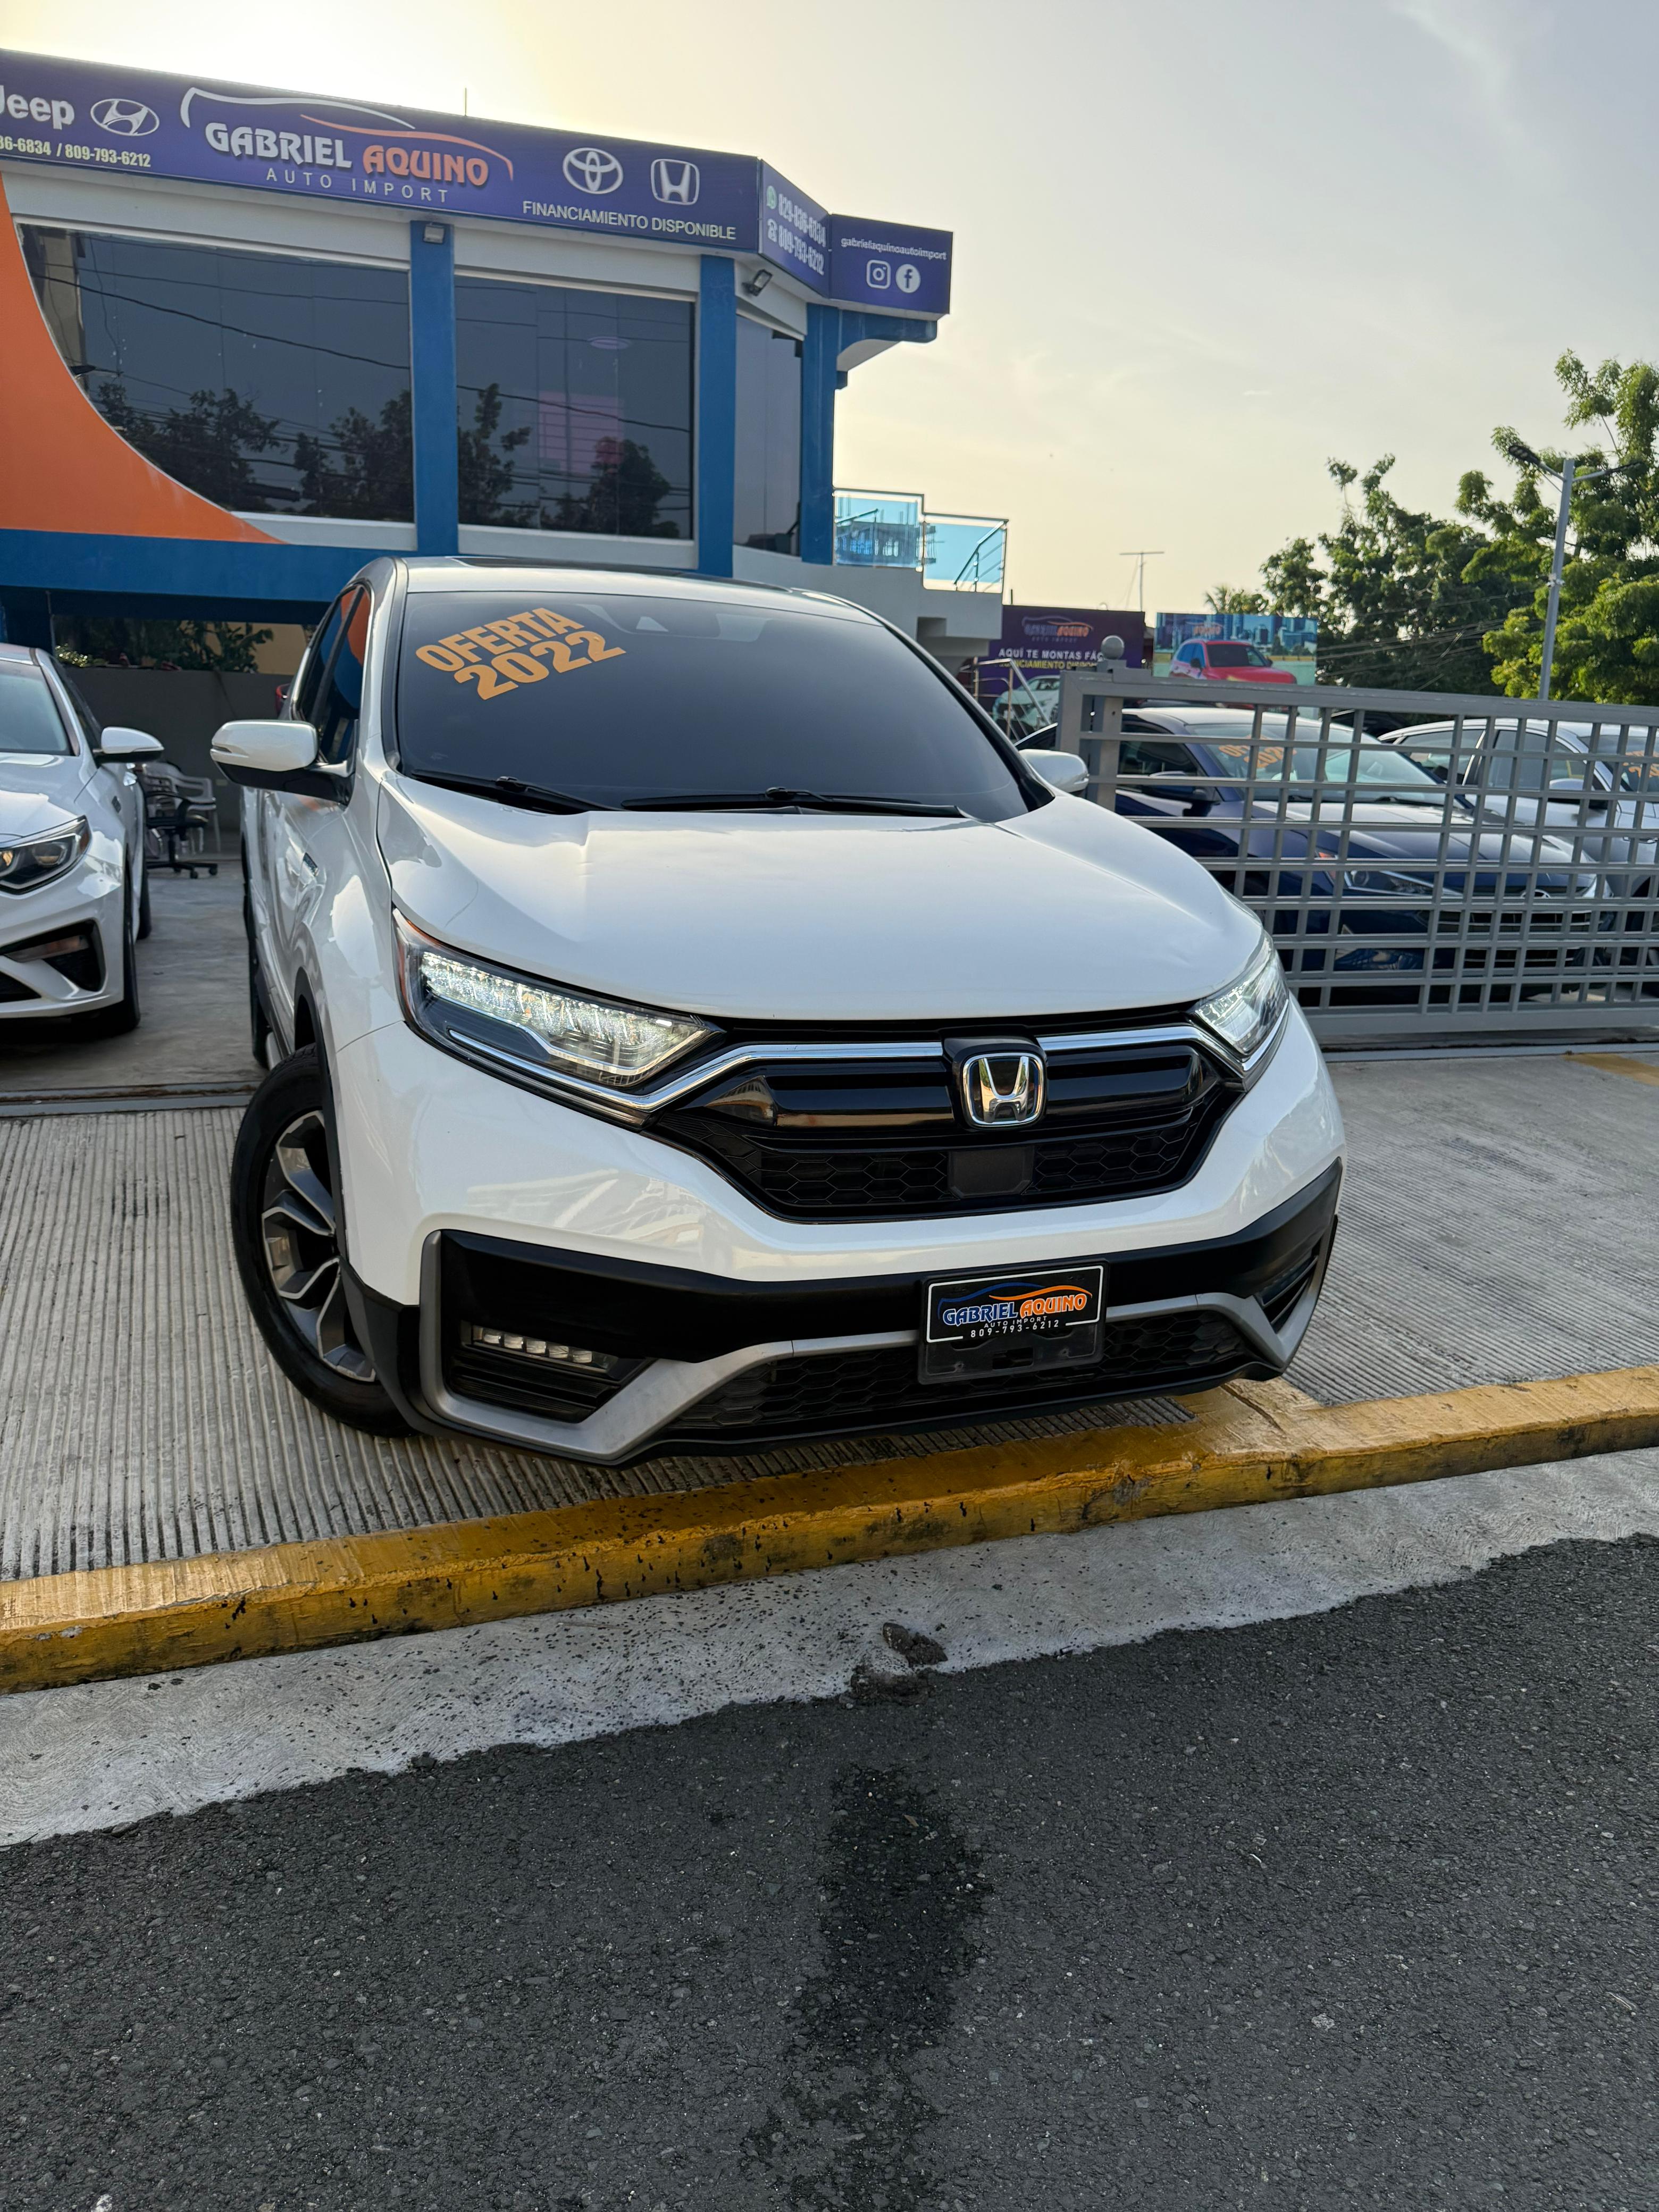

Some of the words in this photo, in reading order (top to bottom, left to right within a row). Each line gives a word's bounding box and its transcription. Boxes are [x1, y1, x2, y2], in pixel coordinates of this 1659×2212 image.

[65, 144, 152, 167] 809-793-6212
[205, 122, 353, 169] GABRIEL
[363, 145, 489, 186] AQUINO
[266, 167, 332, 188] AUTO
[352, 178, 448, 203] IMPORT
[522, 200, 648, 229] FINANCIAMIENTO
[651, 217, 736, 240] DISPONIBLE
[778, 224, 825, 275] 809-793-6212
[841, 237, 947, 260] gabrielaquinoautoimport
[415, 607, 585, 672] OFERTA
[999, 647, 1024, 658] AQUÍ
[1026, 649, 1039, 658] TE
[1042, 650, 1082, 660] MONTAS
[454, 631, 626, 700] 2022
[942, 1301, 1018, 1326] GABRIEL
[1019, 1293, 1087, 1319] AQUINO
[984, 1320, 1008, 1329] AUTO
[1012, 1316, 1048, 1325] IMPORT
[970, 1319, 1060, 1338] 809-793-6212
